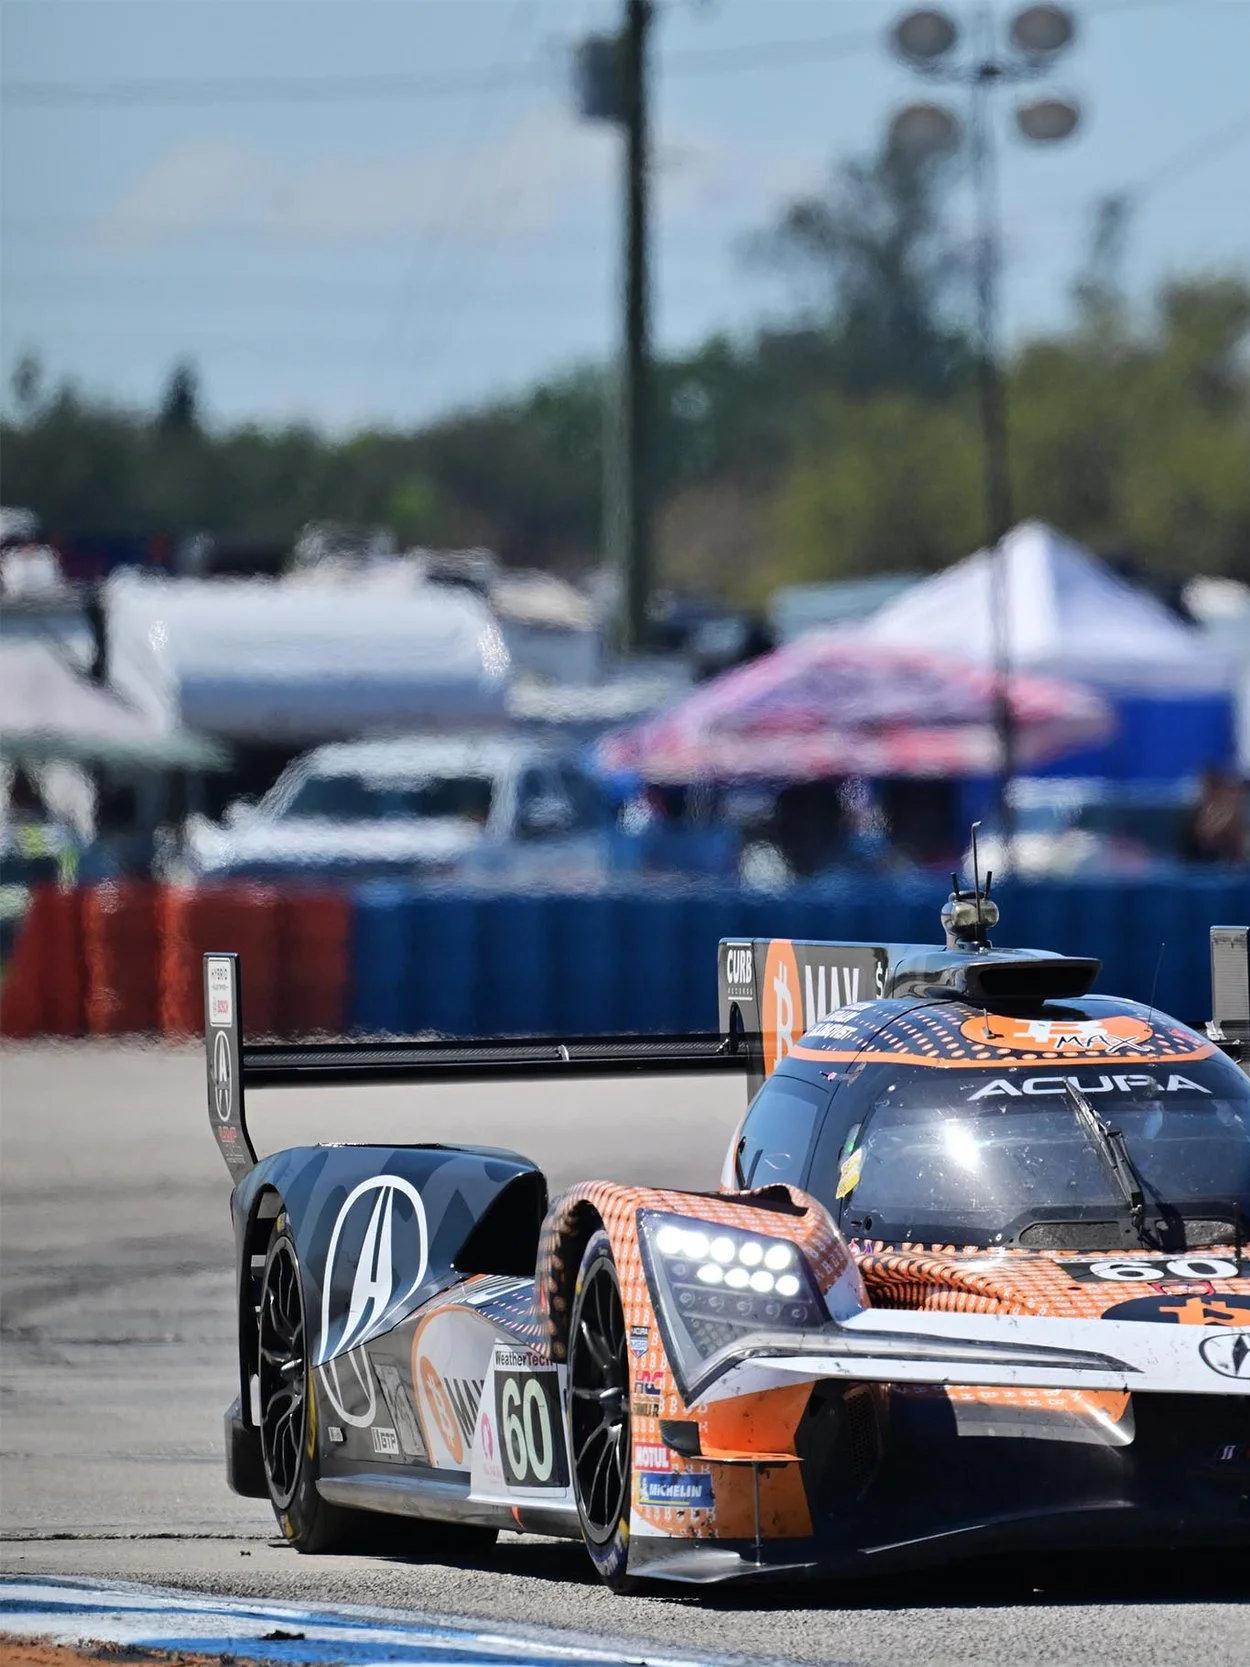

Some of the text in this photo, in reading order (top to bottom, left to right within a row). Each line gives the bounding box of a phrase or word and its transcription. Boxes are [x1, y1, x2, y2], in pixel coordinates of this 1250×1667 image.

[727, 949, 752, 983] CURB
[1054, 1035, 1154, 1053] MAX
[967, 1074, 1212, 1101] ACURA
[1089, 1258, 1239, 1281] 60
[381, 1432, 396, 1449] GTP
[503, 1378, 553, 1482] 60
[635, 1445, 670, 1468] MOTUL
[649, 1483, 702, 1498] MICHELIN
